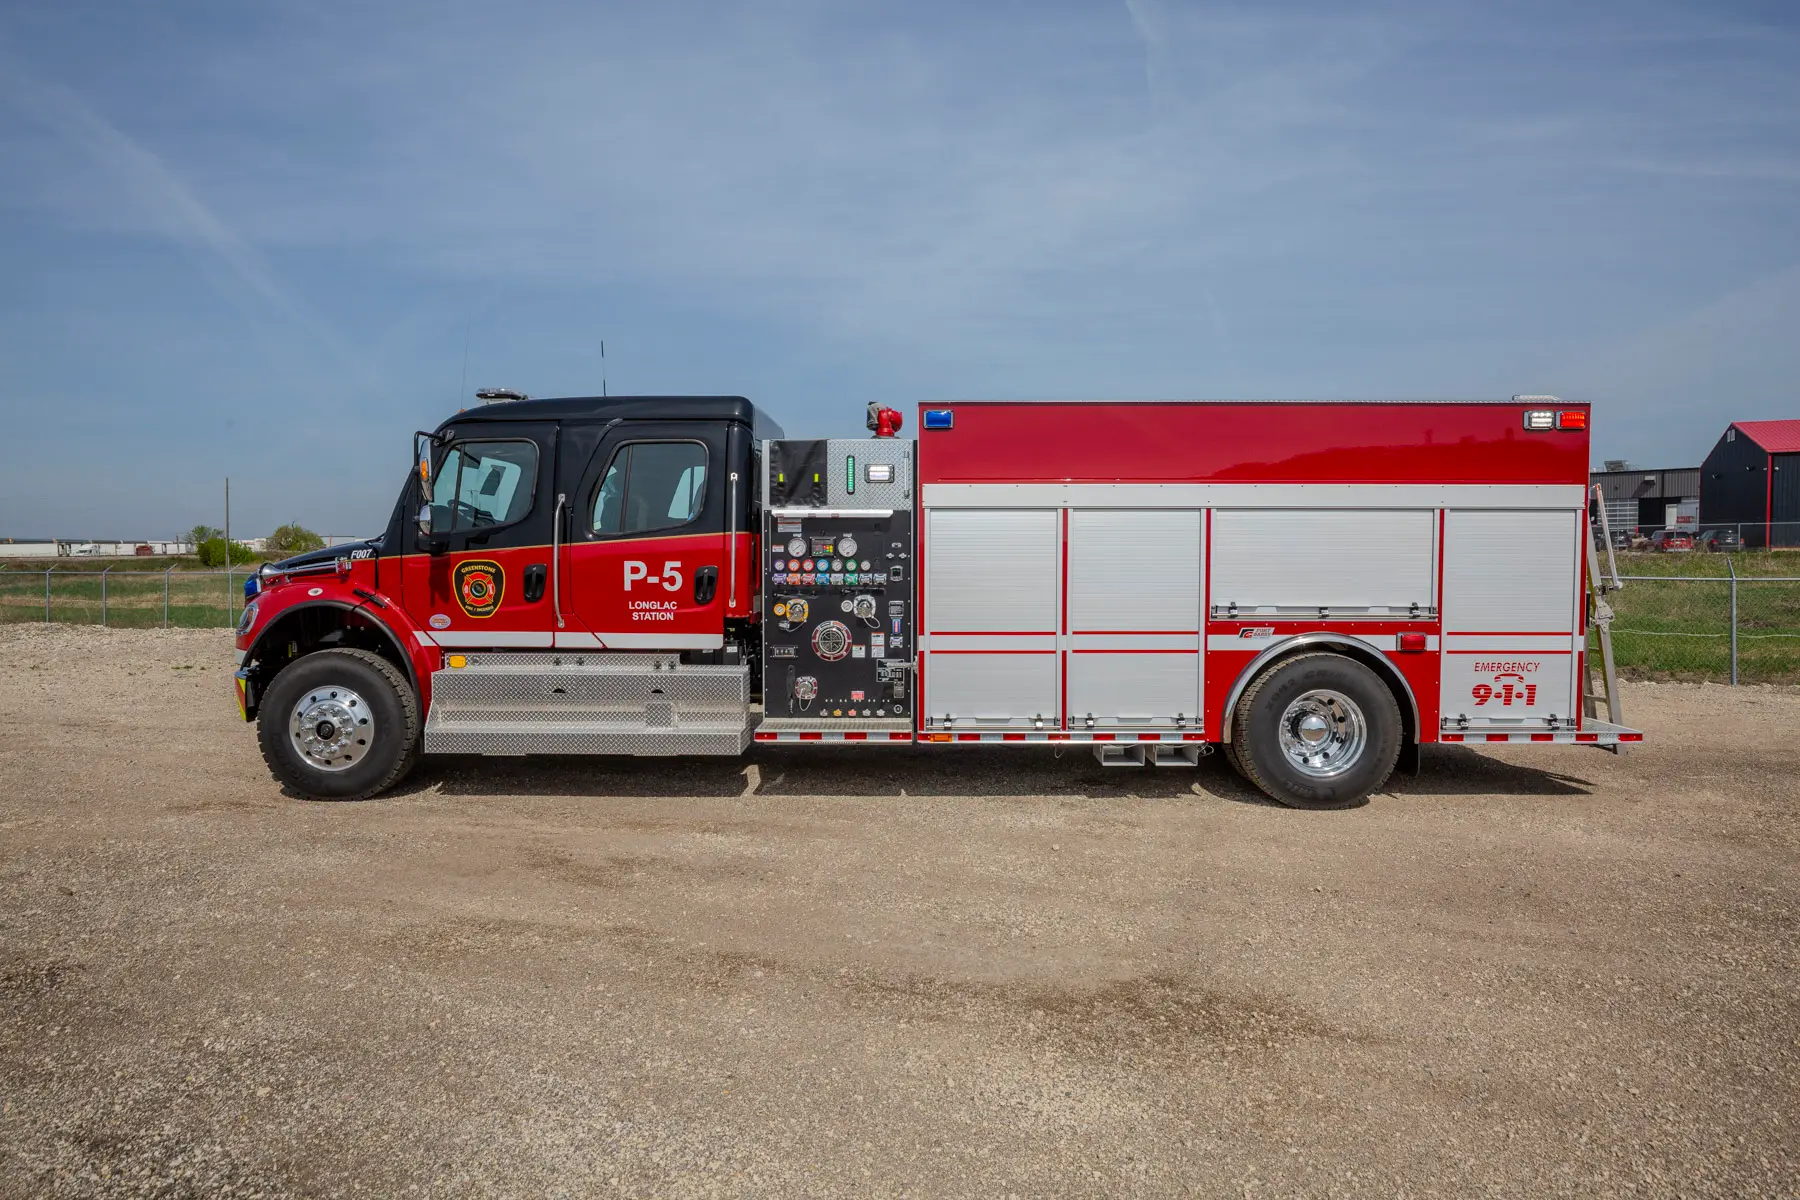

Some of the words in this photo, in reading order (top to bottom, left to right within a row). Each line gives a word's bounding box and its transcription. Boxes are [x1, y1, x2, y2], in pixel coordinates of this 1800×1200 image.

[351, 549, 373, 559] F007
[461, 565, 496, 573] GREENSTONE
[624, 560, 683, 592] P-5
[628, 600, 678, 610] LONGLAC
[632, 611, 674, 621] STATION
[1474, 662, 1540, 672] EMERGENCY
